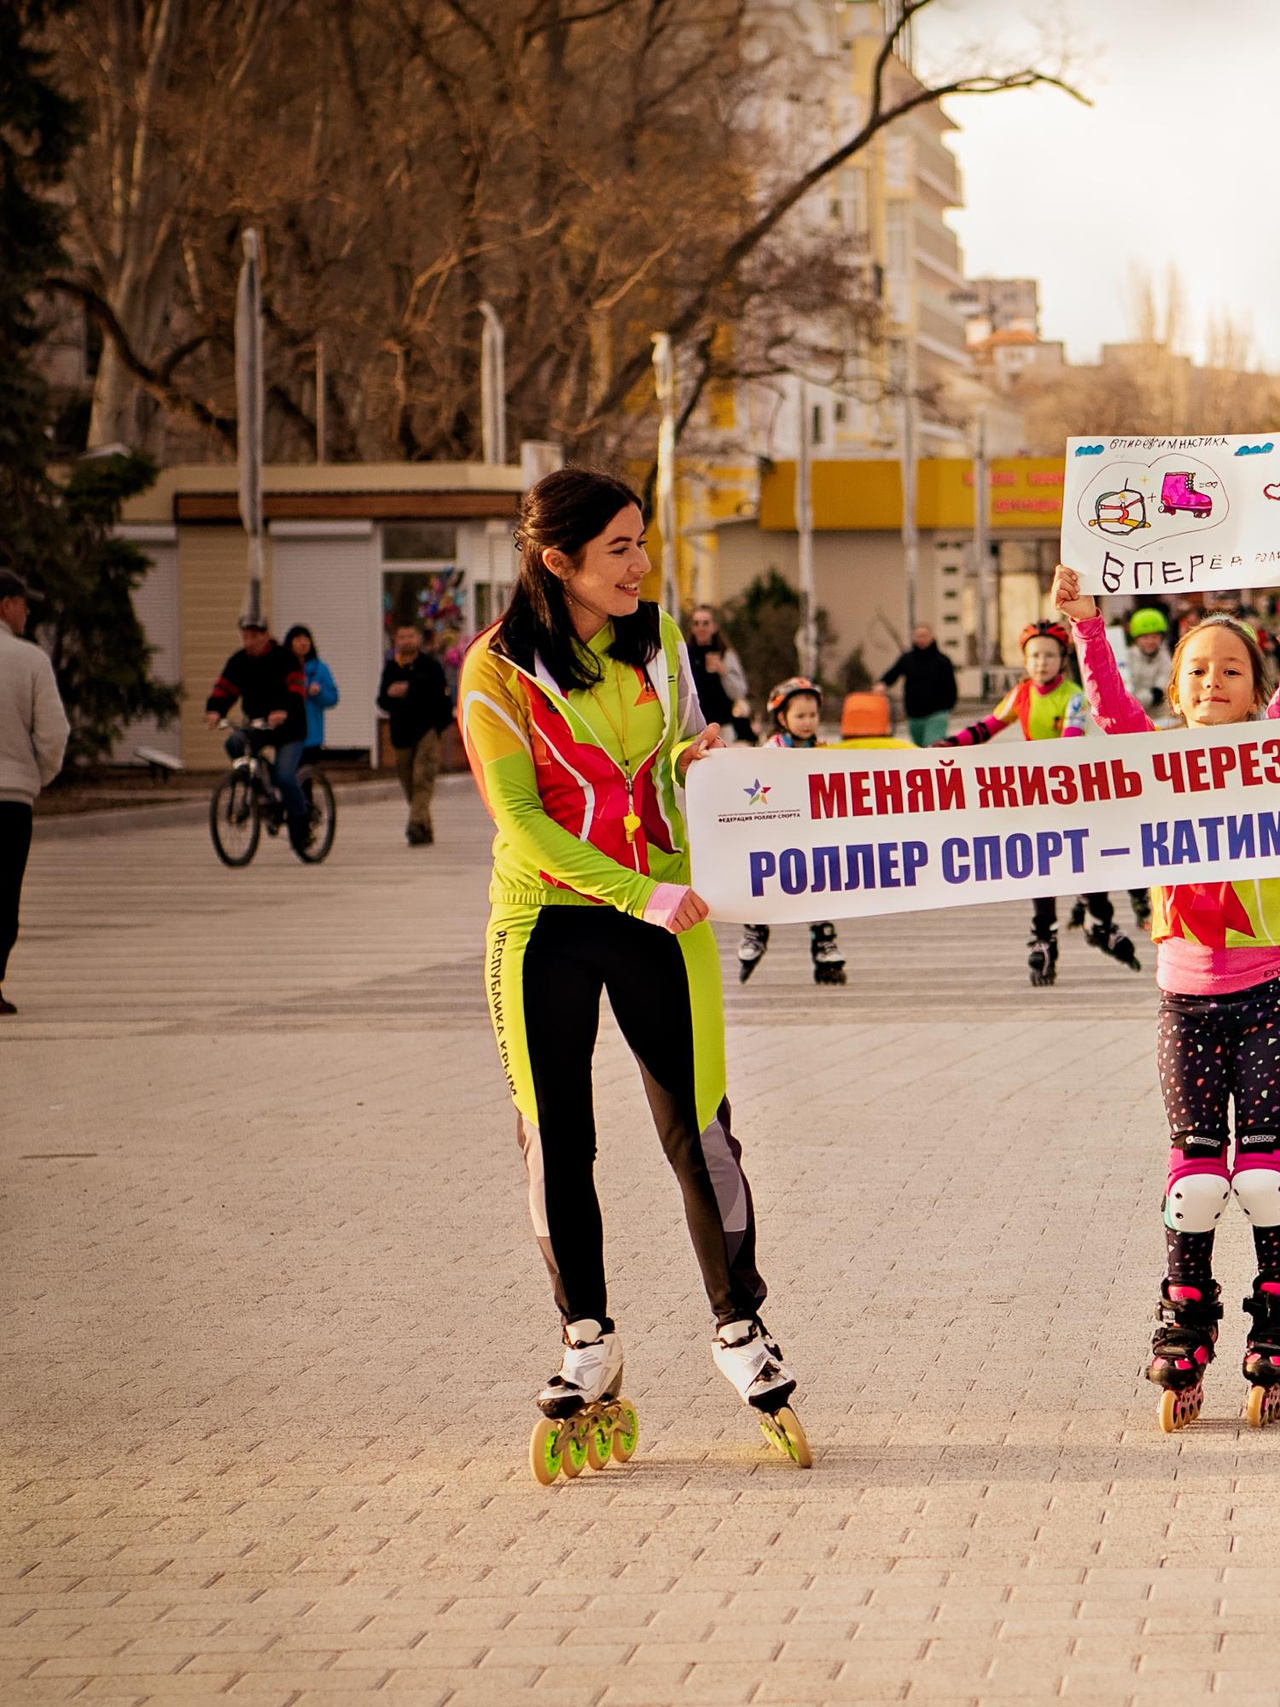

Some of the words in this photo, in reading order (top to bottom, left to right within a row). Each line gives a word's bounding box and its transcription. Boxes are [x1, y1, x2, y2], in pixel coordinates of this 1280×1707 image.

[718, 815, 753, 823] ФЕДЕРАЦИЯ
[754, 813, 777, 821] РОЛЛЕР
[808, 759, 966, 820] МЕНЯЙ
[974, 759, 1142, 809] ЖИЗНЬ
[749, 841, 928, 897] РОЛЛЕР
[941, 828, 1089, 883] СПОРТ
[491, 930, 507, 1037] РЕСПУБЛИКА
[500, 1040, 518, 1096] КРЫМ
